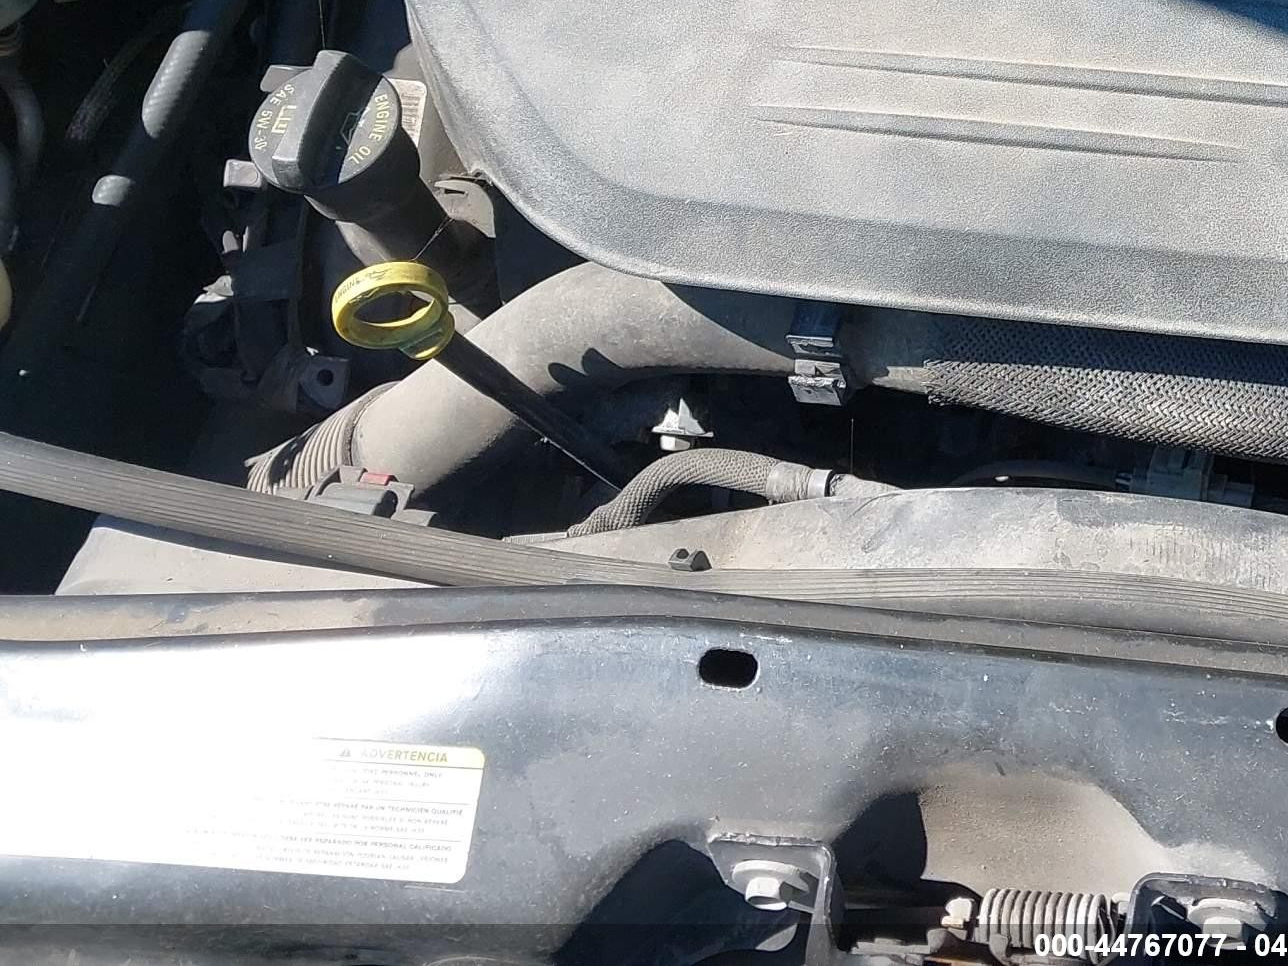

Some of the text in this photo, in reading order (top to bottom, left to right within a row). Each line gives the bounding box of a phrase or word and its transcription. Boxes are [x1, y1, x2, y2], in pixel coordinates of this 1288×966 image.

[270, 84, 295, 106] SAE
[348, 94, 390, 165] ENGINE OIL
[360, 747, 448, 763] ADVERTENCIA
